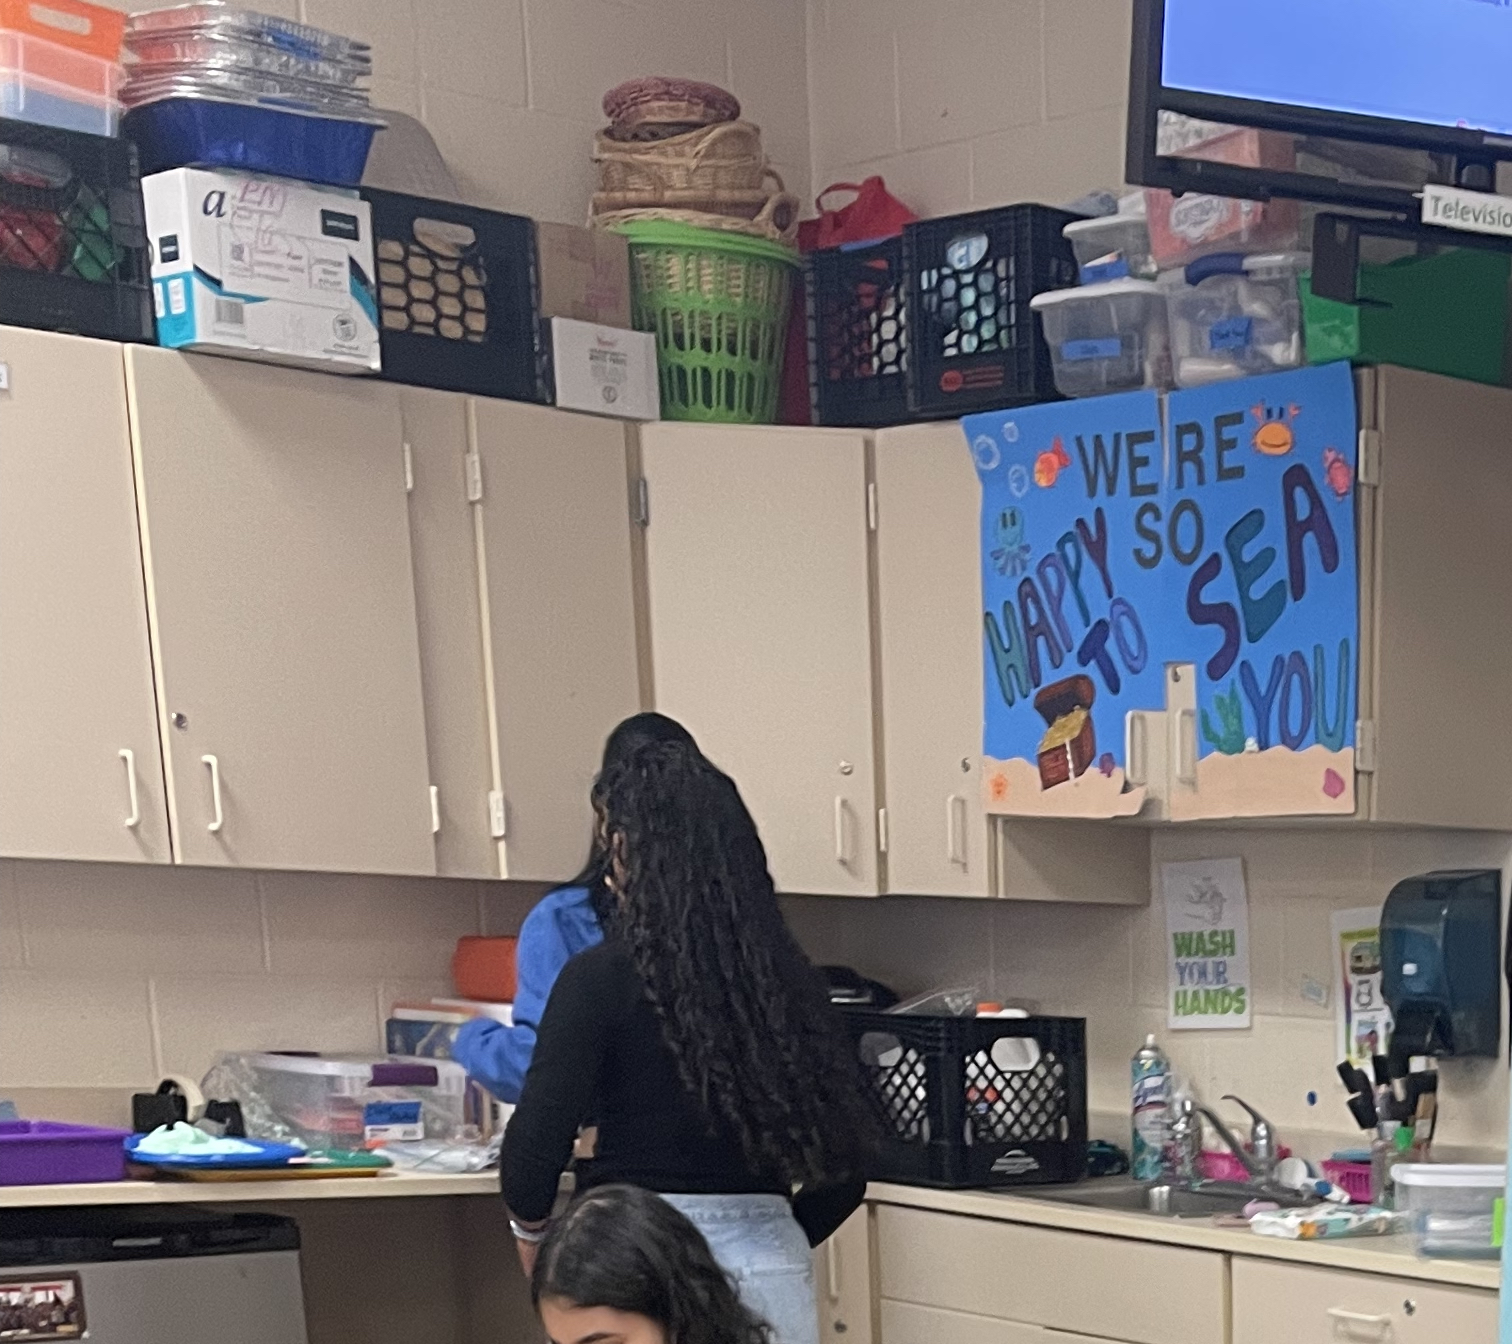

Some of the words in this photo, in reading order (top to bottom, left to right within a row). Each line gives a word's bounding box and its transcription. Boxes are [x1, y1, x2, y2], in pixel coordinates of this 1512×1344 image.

[1133, 498, 1205, 569] SO
[1186, 462, 1340, 681] SEA
[984, 506, 1114, 708] HAPPY
[1078, 597, 1149, 695] TO
[1239, 637, 1351, 752] YOU
[1173, 929, 1236, 958] WASH
[1175, 960, 1228, 986] YOUR
[1173, 986, 1247, 1016] HANDS
